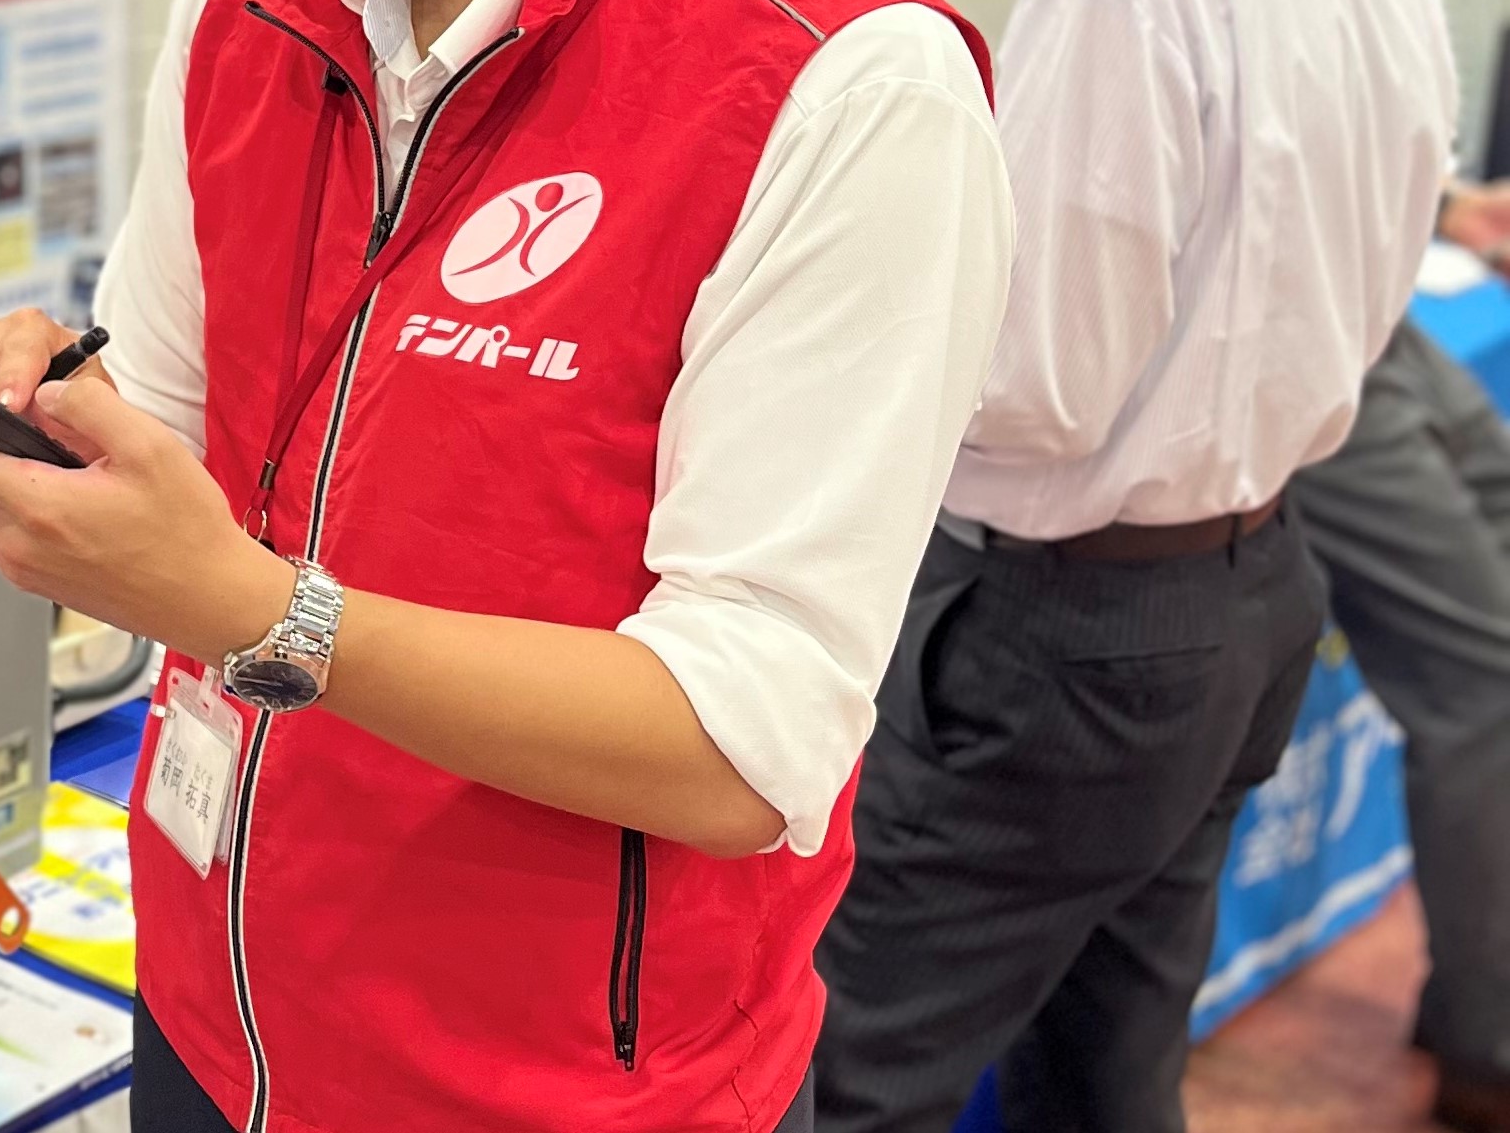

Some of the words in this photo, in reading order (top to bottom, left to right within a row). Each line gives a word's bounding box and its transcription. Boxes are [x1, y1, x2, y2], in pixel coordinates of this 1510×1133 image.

[395, 314, 580, 381] テンパール
